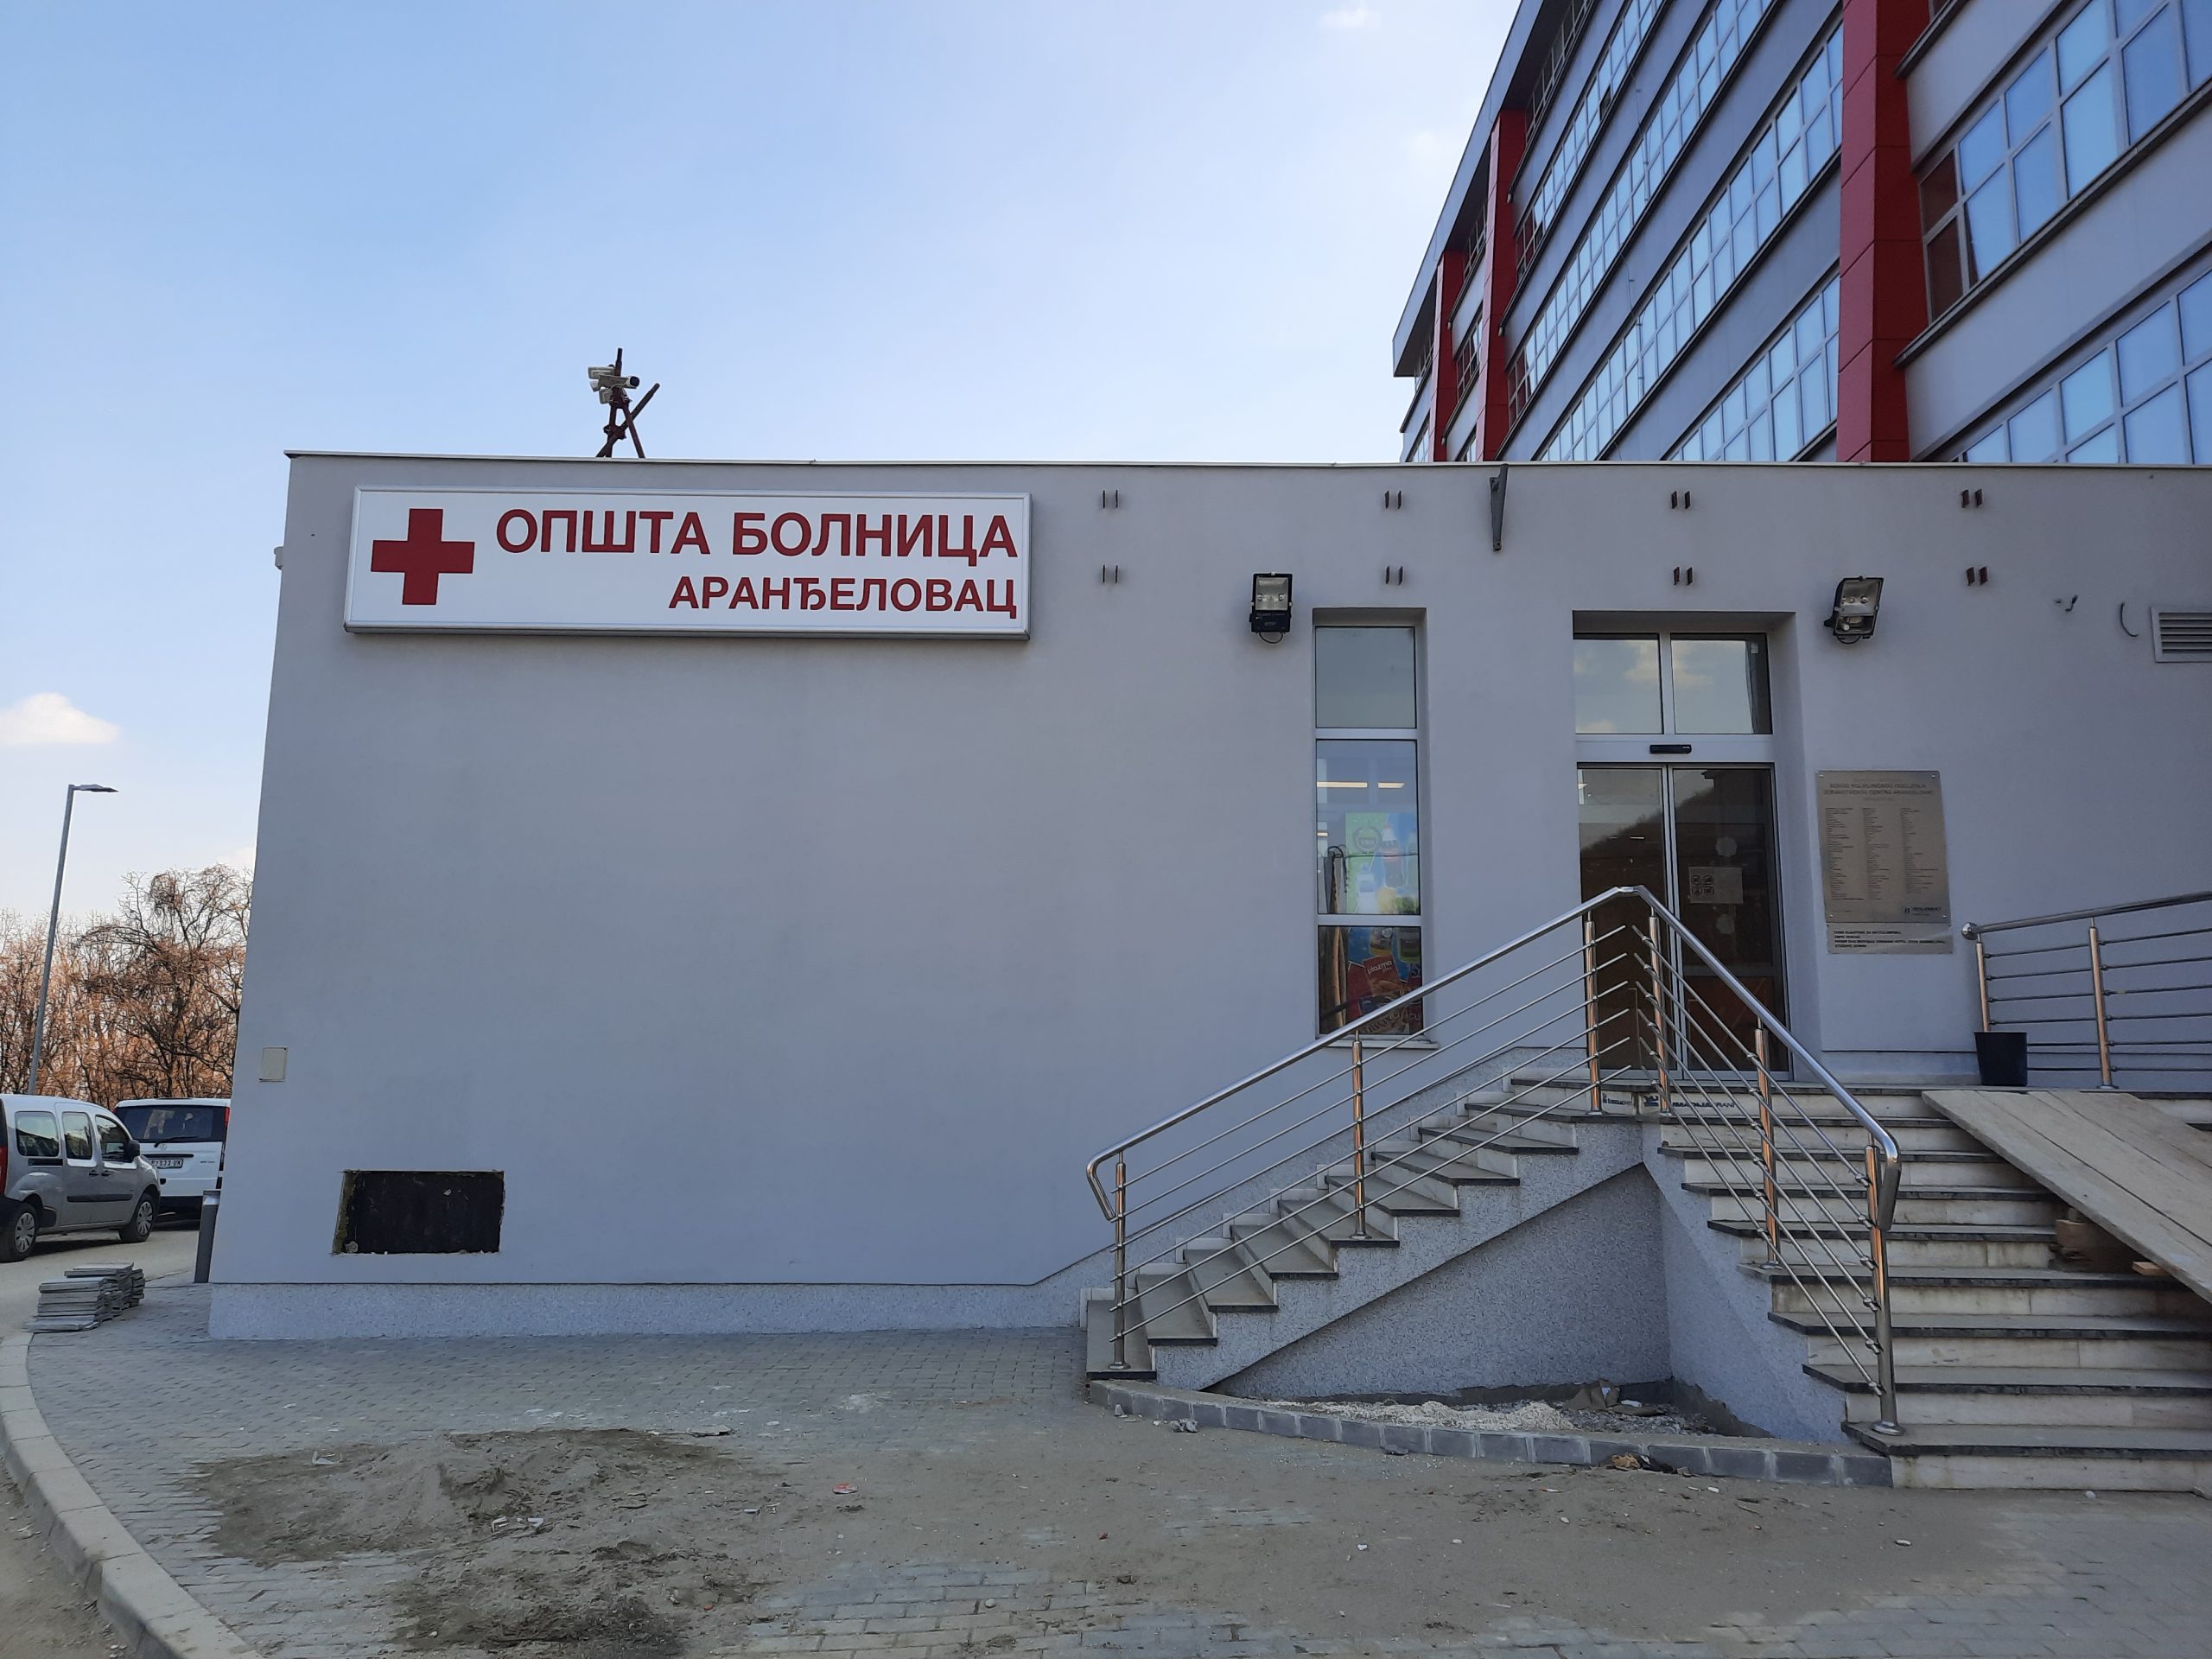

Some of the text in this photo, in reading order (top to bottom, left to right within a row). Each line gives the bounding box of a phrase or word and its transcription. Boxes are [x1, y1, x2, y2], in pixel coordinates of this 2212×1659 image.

[497, 509, 1018, 567] ОПШТА БОЛНИЦА
[669, 576, 1017, 619] АРАНЂЕЛОВАЦ
[1367, 960, 1393, 975] plazma
